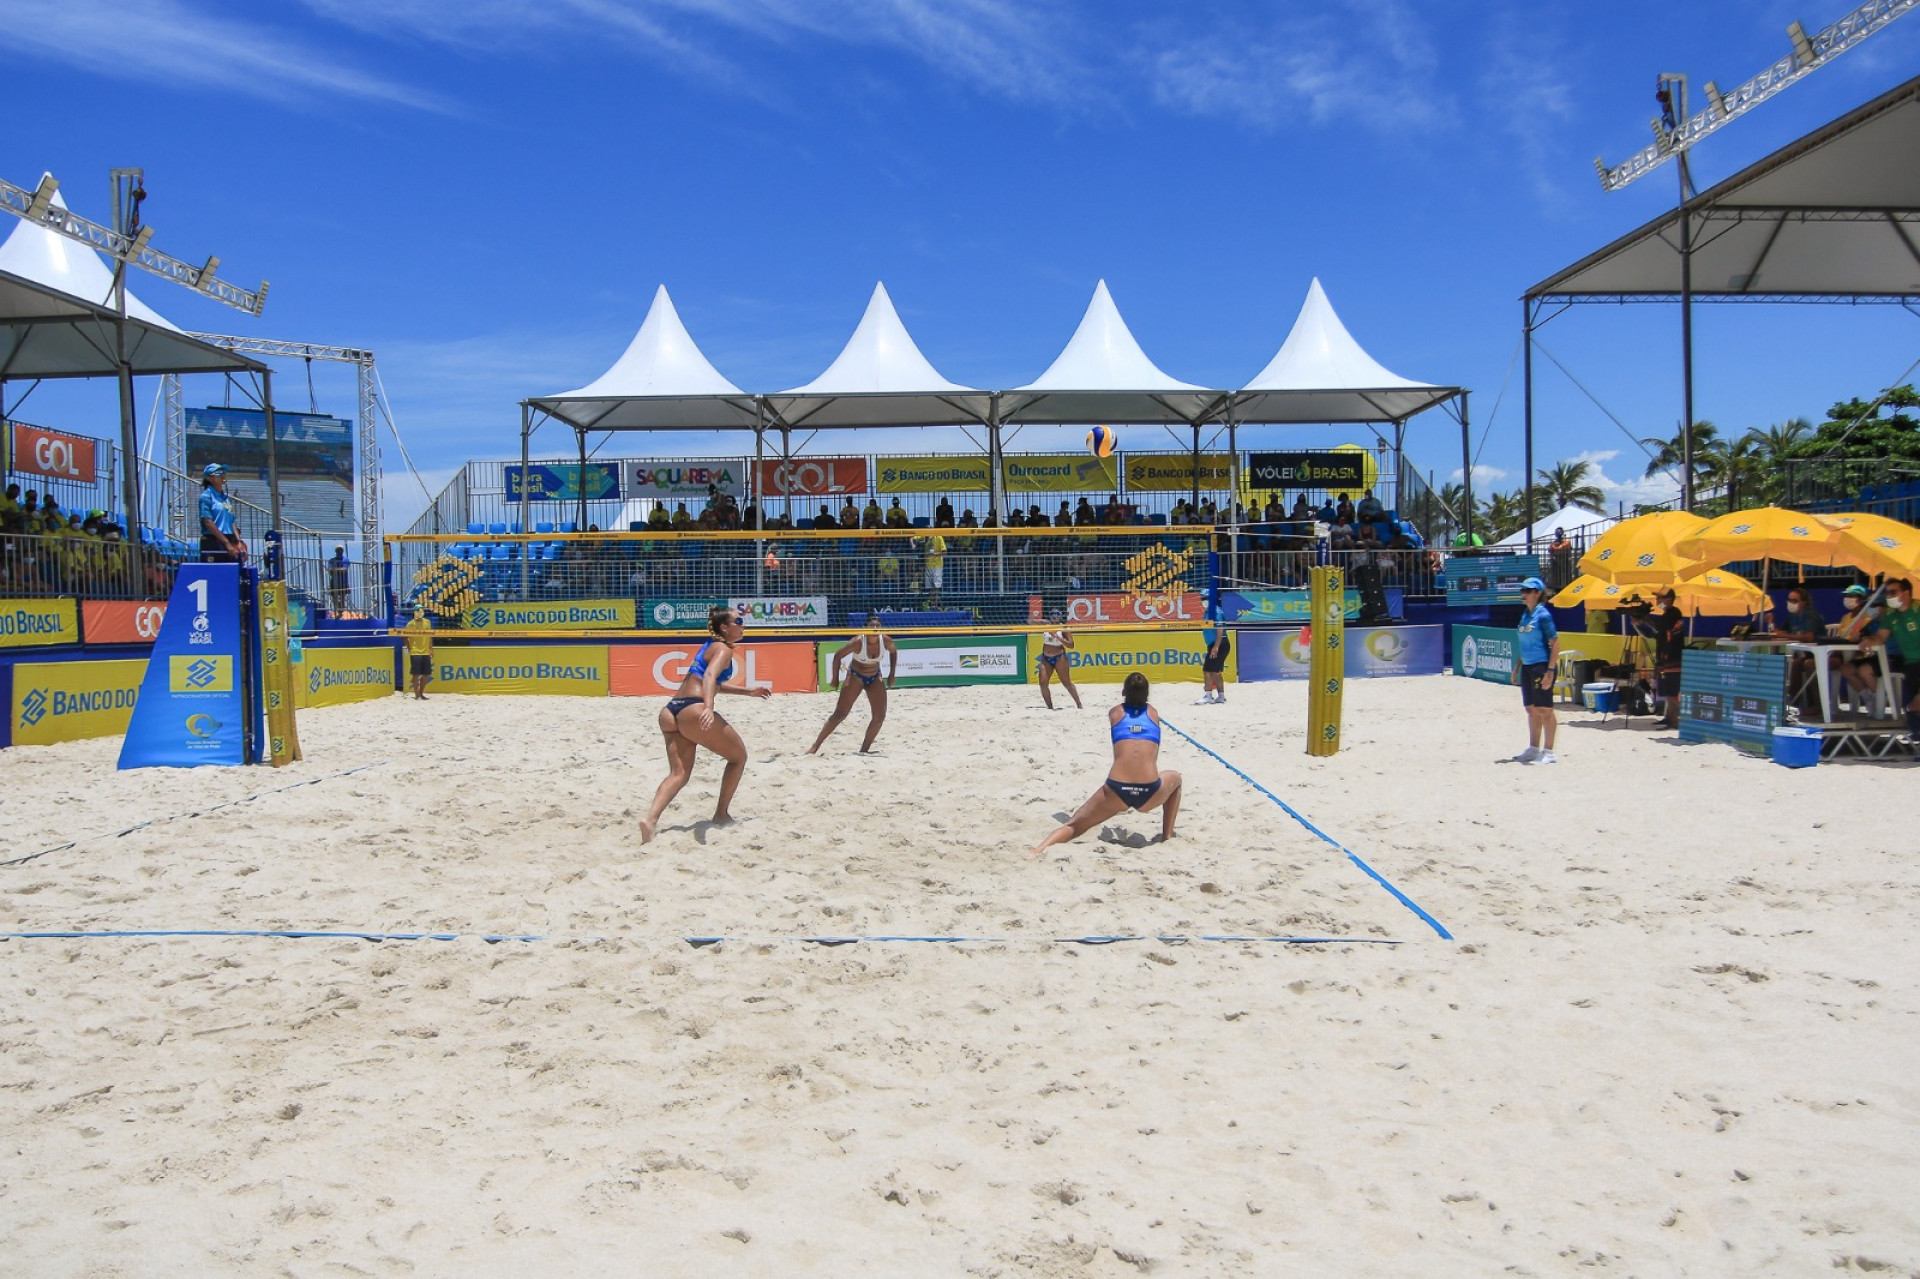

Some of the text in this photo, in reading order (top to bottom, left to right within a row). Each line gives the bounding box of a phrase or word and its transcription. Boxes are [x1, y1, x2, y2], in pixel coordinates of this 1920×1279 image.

[35, 437, 79, 475] GOL
[636, 468, 734, 489] SAQUAREMA
[774, 462, 846, 492] GOL
[899, 468, 987, 480] BANCO DO BRASIL
[1008, 463, 1071, 476] Ourocard
[1148, 467, 1183, 478] BANCO
[1256, 465, 1358, 479] VÔLEI BRASIL
[187, 579, 207, 612] 1
[495, 607, 619, 624] BANCO DO BRASIL
[737, 602, 817, 620] SAQUAREMA
[1067, 597, 1109, 621] OL
[1134, 595, 1191, 620] GOL
[17, 611, 63, 635] BRASIL
[135, 606, 167, 638] GO
[980, 658, 1011, 667] BRASIL
[1067, 649, 1207, 668] BANCO DO BRA
[324, 667, 392, 687] BANCO DO BRASIL
[440, 663, 601, 681] BANCO DO BRASIL
[652, 650, 774, 691] GL
[53, 688, 135, 716] BANCO DO
